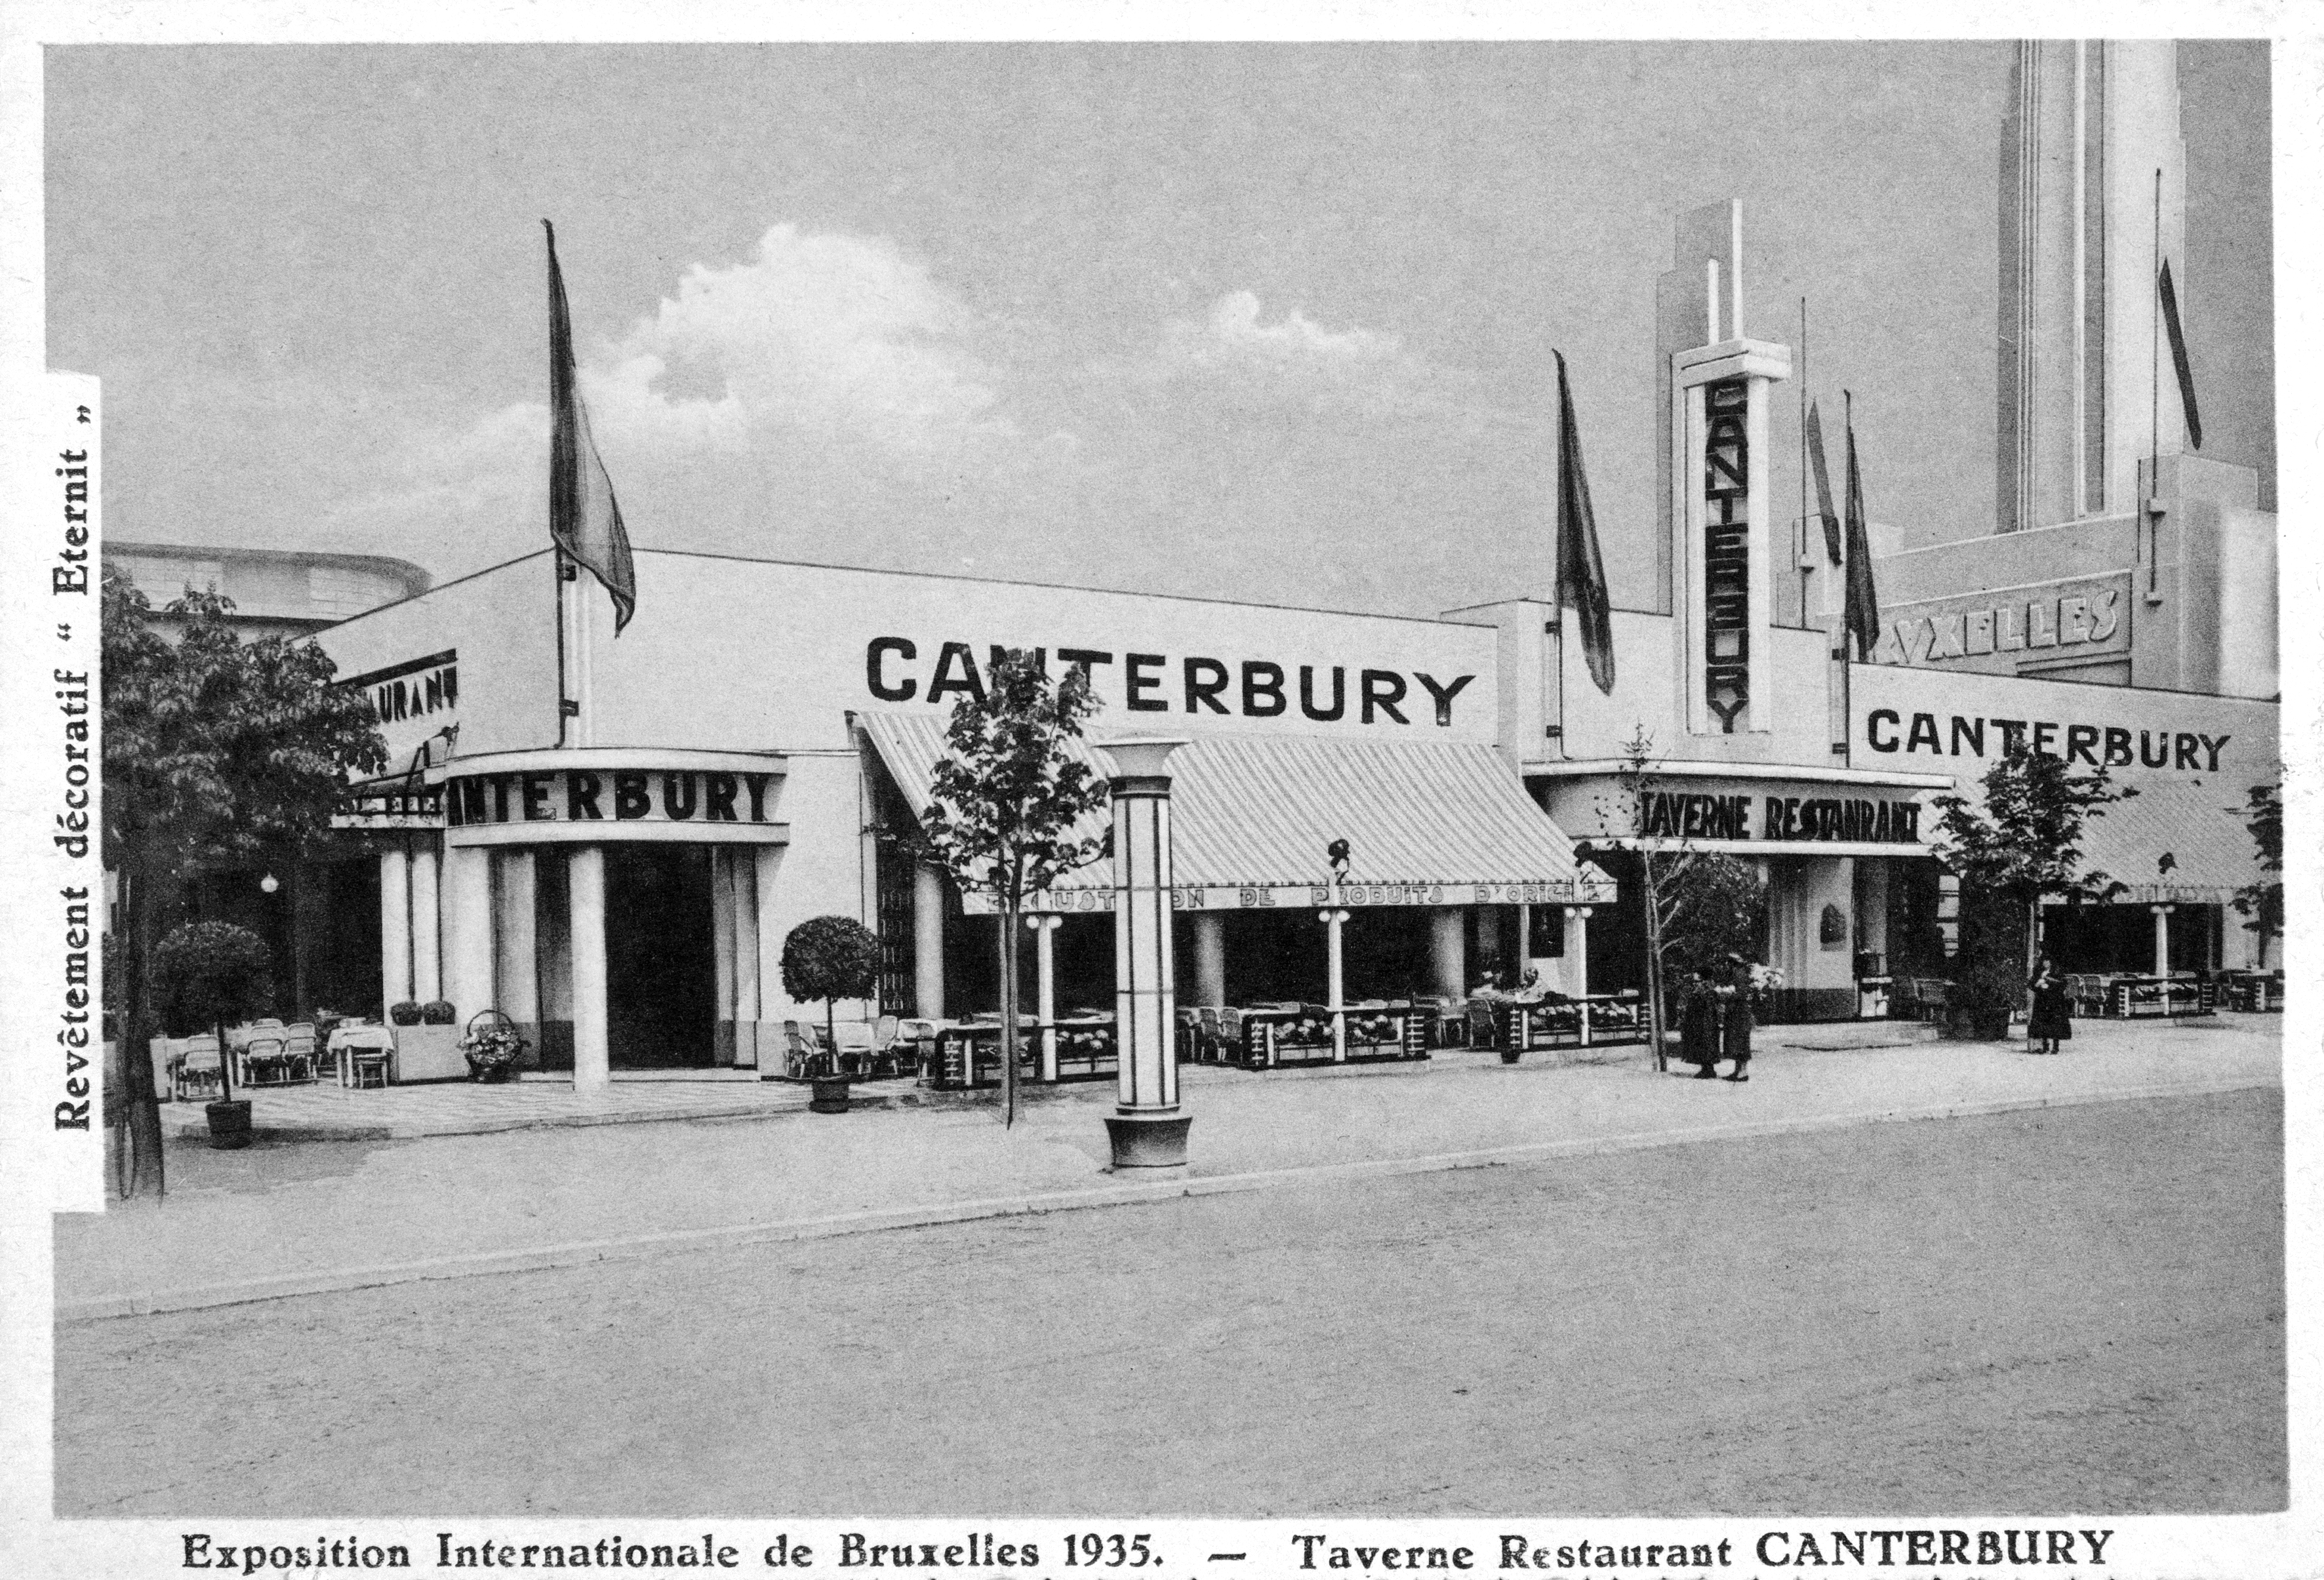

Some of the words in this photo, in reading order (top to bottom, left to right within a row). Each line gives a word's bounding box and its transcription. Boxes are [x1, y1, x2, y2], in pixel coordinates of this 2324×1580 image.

[1705, 379, 1750, 734] CANTERBURY
[368, 665, 459, 723] URANT
[1868, 708, 2232, 772] CANTERBURY
[1641, 791, 1752, 840] TAVERNE
[1239, 888, 1276, 907] DE
